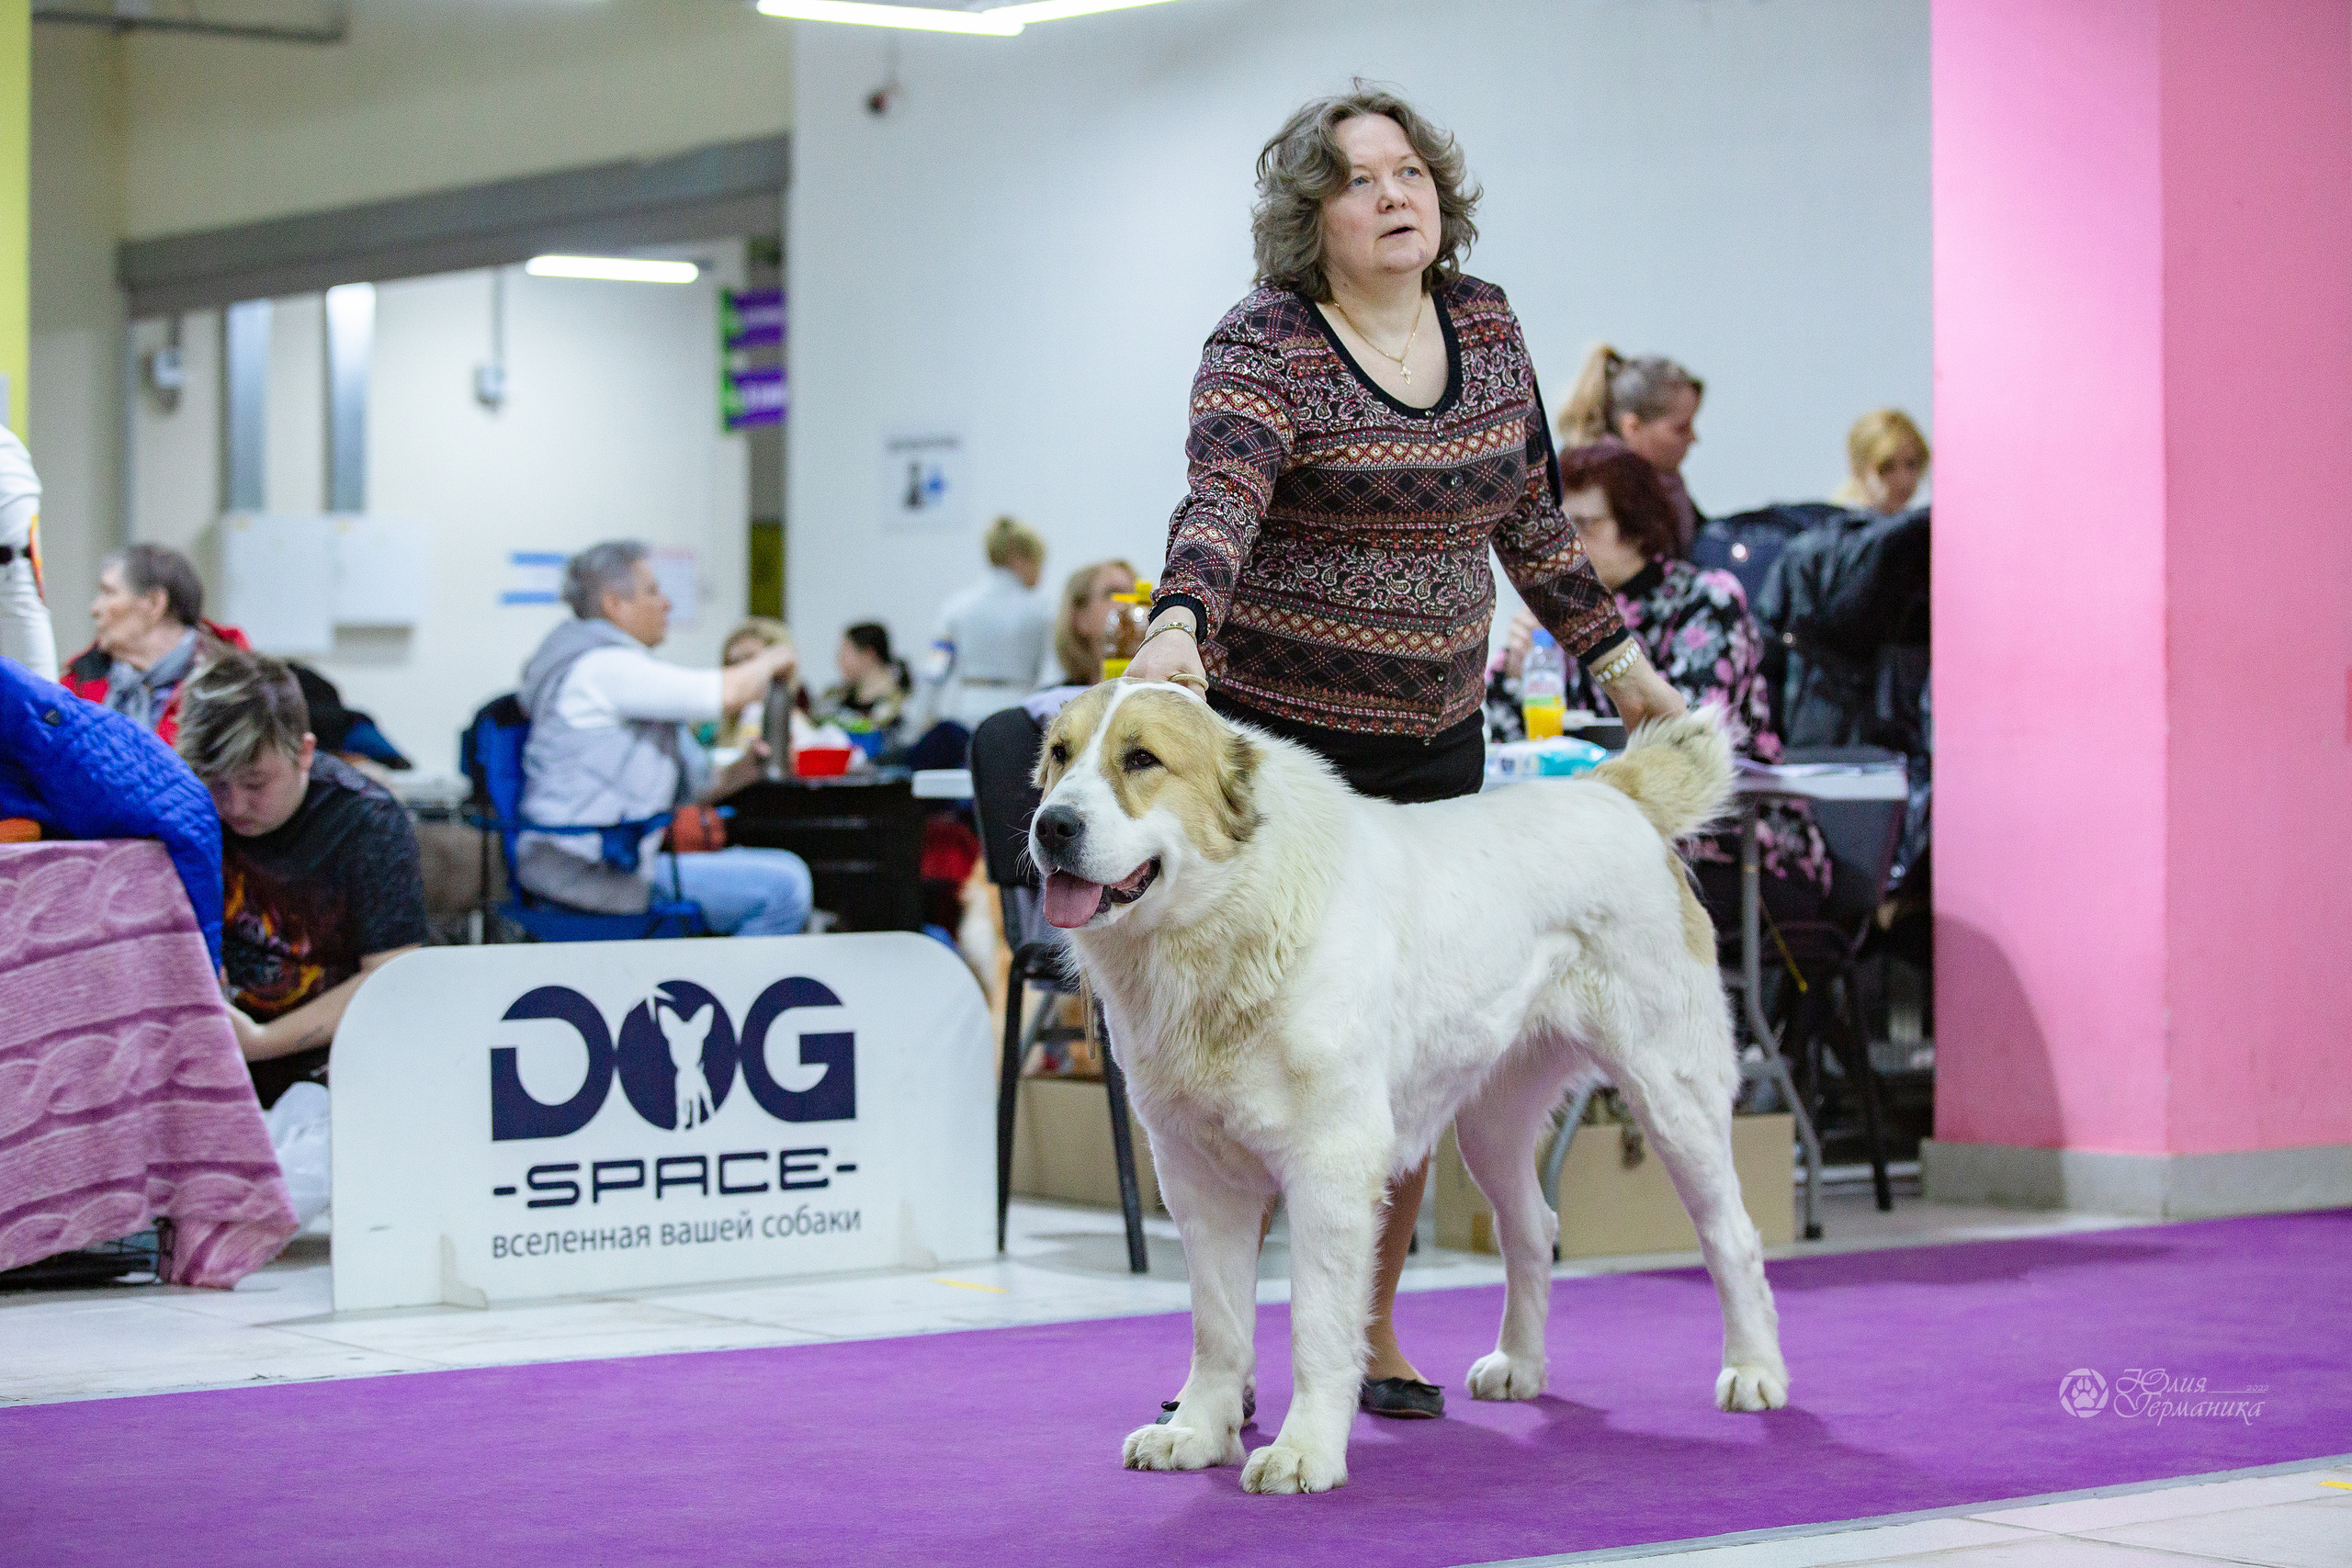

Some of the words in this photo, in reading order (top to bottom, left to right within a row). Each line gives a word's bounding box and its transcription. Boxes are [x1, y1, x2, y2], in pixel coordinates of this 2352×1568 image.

[491, 976, 856, 1142] DOG
[492, 1225, 650, 1258] вселенная
[660, 1211, 753, 1247] вашей
[762, 1204, 862, 1239] собаки
